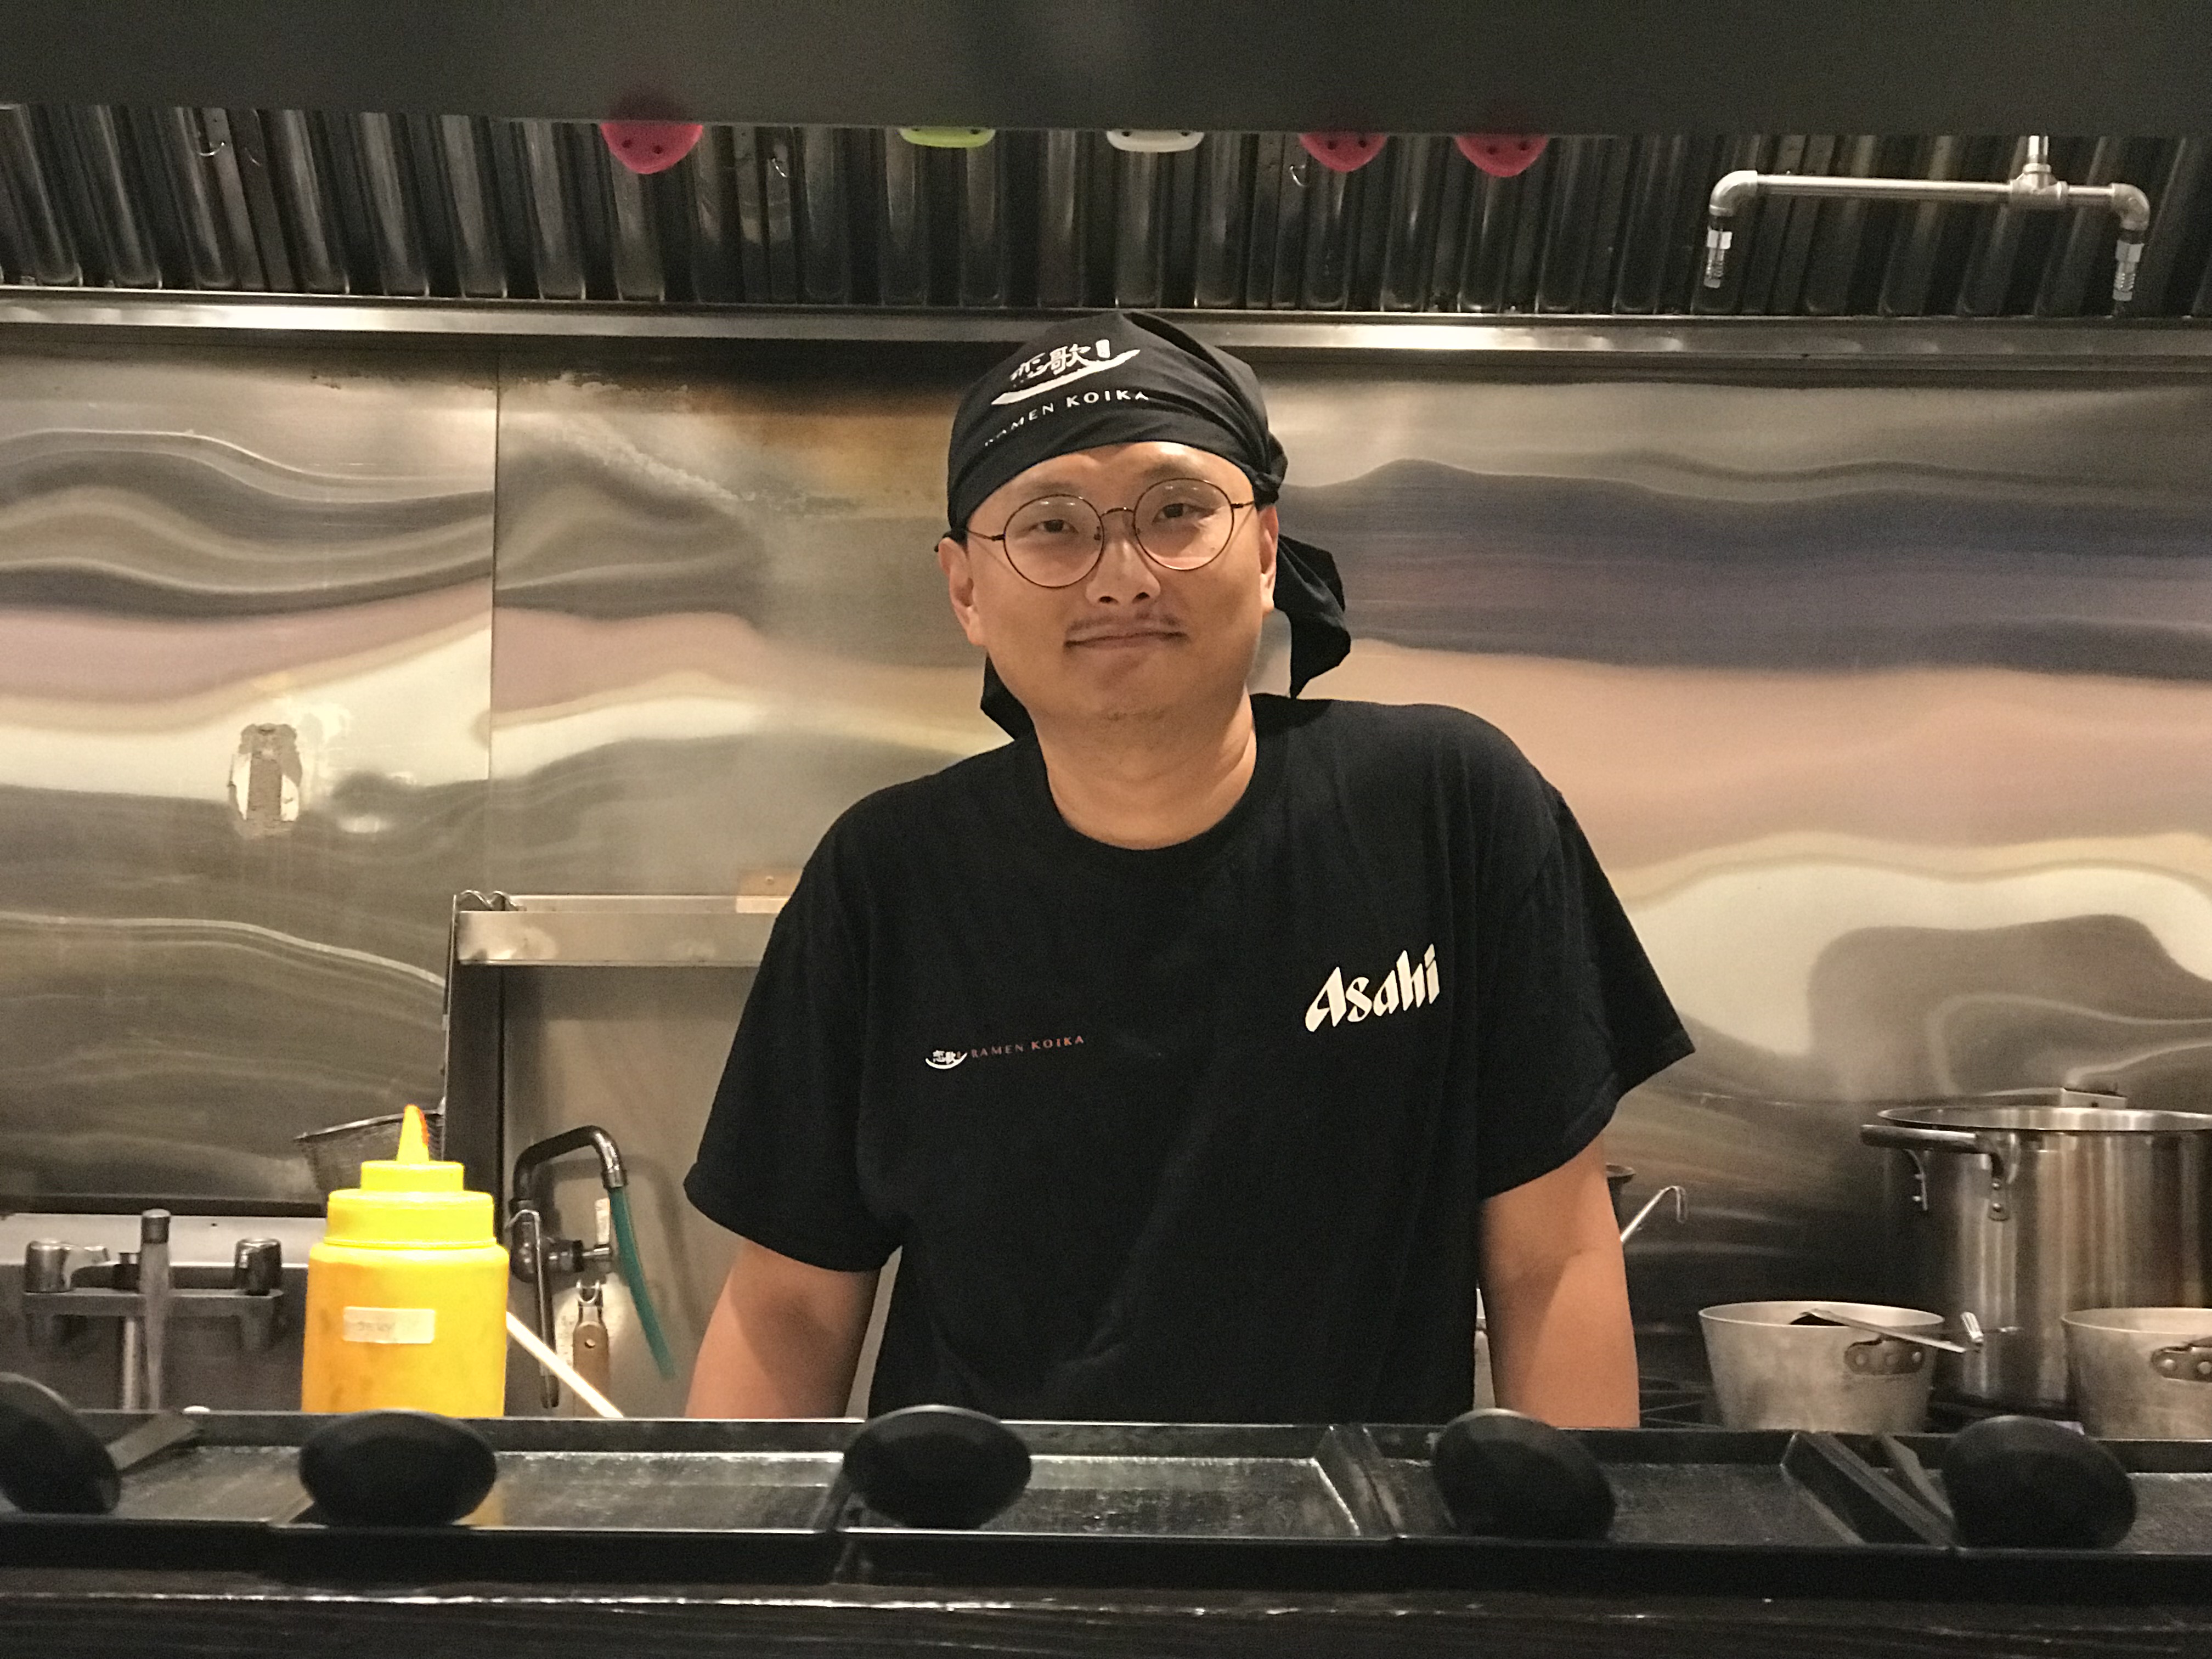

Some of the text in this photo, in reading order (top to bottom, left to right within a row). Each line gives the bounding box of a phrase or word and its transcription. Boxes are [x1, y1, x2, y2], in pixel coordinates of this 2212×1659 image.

[1066, 390, 1149, 408] KOIKA
[1305, 943, 1440, 1032] Asahi
[970, 1044, 1024, 1058] RAMEN
[1031, 1035, 1085, 1051] KOIKA
